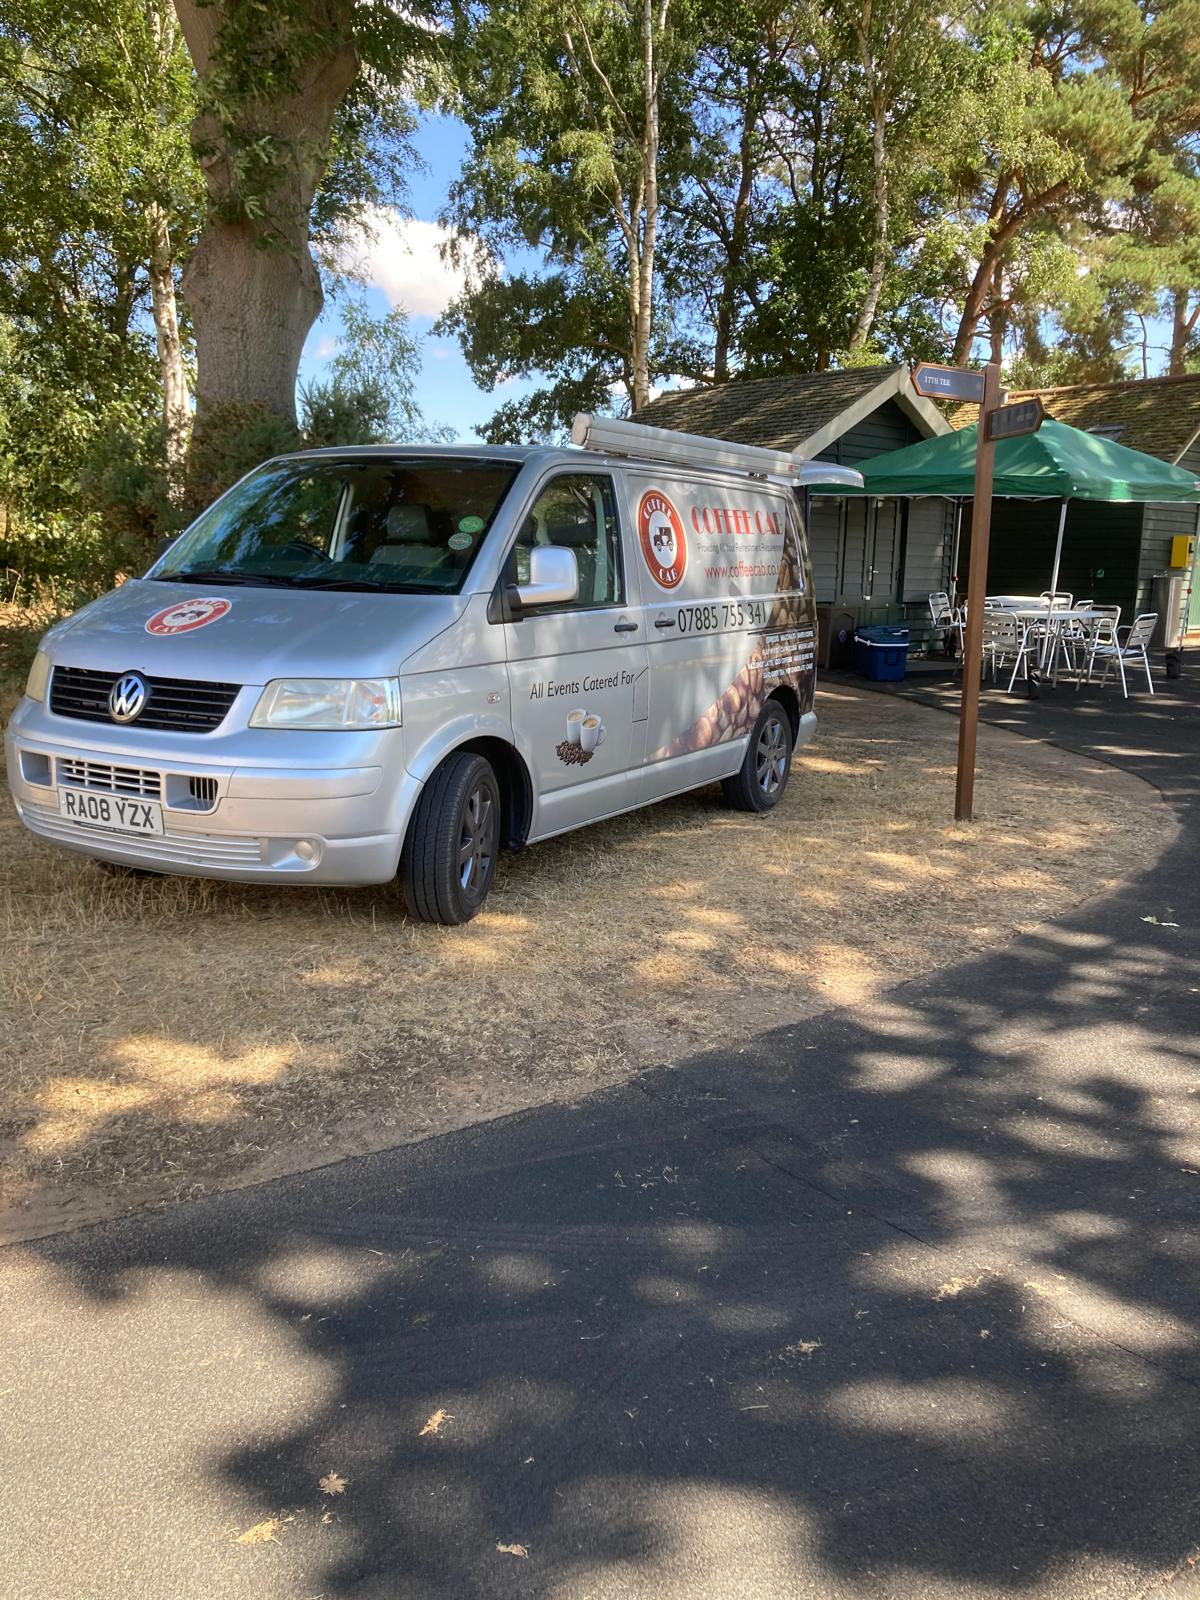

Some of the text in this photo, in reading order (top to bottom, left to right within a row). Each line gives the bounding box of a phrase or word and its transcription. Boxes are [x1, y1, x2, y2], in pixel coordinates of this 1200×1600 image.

[643, 498, 672, 520] COFFEE
[691, 505, 784, 536] COFFEE CAB
[659, 567, 678, 582] CAB
[677, 602, 766, 633] 07885 755 341
[529, 670, 635, 700] All Events Catered For
[65, 791, 111, 822] RA08
[115, 801, 154, 829] YZX
